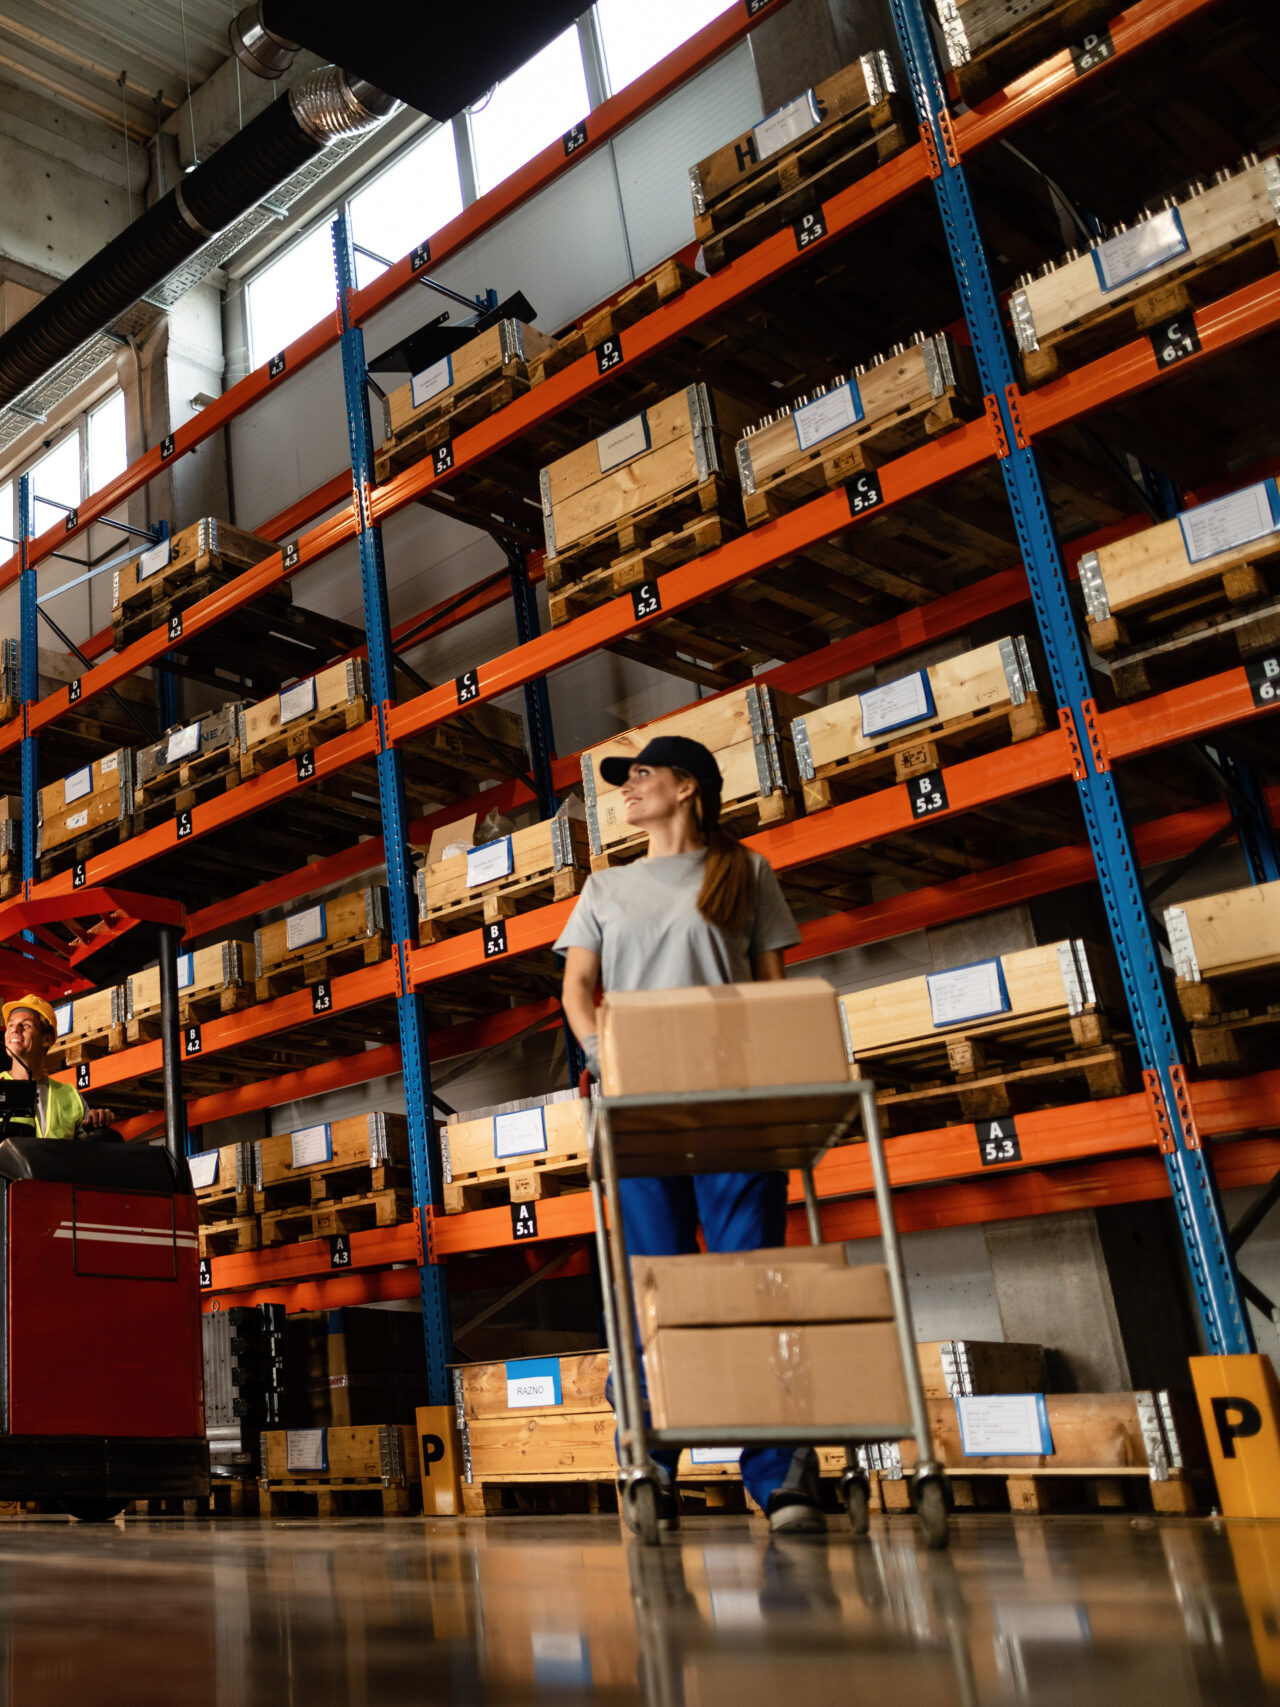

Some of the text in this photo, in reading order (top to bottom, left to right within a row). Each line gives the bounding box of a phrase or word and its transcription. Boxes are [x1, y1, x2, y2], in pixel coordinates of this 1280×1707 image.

[1084, 35, 1097, 50] D
[1080, 44, 1108, 68] 6.1
[570, 127, 578, 137] E
[567, 135, 584, 152] 5.2
[734, 136, 758, 173] H
[803, 214, 814, 228] D
[800, 225, 822, 245] 5.3
[414, 253, 428, 268] 5.1
[1167, 323, 1180, 340] C
[604, 342, 613, 355] D
[1163, 337, 1193, 360] 6.1
[601, 352, 620, 371] 5.2
[272, 362, 284, 375] 4.3
[165, 438, 169, 446] E
[163, 444, 174, 457] 4.2
[439, 448, 447, 459] D
[437, 456, 451, 473] 5.1
[857, 478, 867, 492] C
[854, 494, 878, 512] 5.3
[67, 517, 77, 529] 4.1
[287, 546, 293, 554] D
[285, 555, 297, 567] 4.3
[640, 587, 649, 598] C
[638, 598, 657, 615] 5.2
[172, 618, 177, 626] D
[170, 625, 181, 638] 4.2
[1263, 659, 1280, 677] B
[72, 681, 78, 689] D
[464, 673, 471, 684] C
[70, 688, 80, 699] 4.1
[461, 686, 476, 700] 5.1
[302, 754, 308, 764] C
[300, 765, 313, 778] 4.3
[920, 777, 932, 793] B
[917, 794, 942, 813] 5.3
[181, 814, 187, 824] C
[179, 824, 191, 836] 4.2
[77, 865, 82, 874] C
[75, 874, 84, 885] 4.1
[491, 925, 499, 938] B
[487, 939, 504, 953] 5.1
[318, 985, 324, 997] B
[315, 997, 330, 1009] 4.3
[190, 1029, 196, 1039] B
[187, 1040, 200, 1052] 4.2
[81, 1065, 86, 1076] B
[78, 1075, 89, 1087] 4.1
[990, 1121, 1003, 1139] A
[985, 1140, 1015, 1160] 5.3
[520, 1205, 529, 1219] A
[516, 1220, 533, 1235] 5.1
[336, 1238, 344, 1250] A
[334, 1251, 348, 1264] 4.3
[200, 1261, 206, 1272] A
[517, 1385, 544, 1396] RAZNO
[1210, 1396, 1262, 1459] P
[422, 1434, 444, 1476] P
